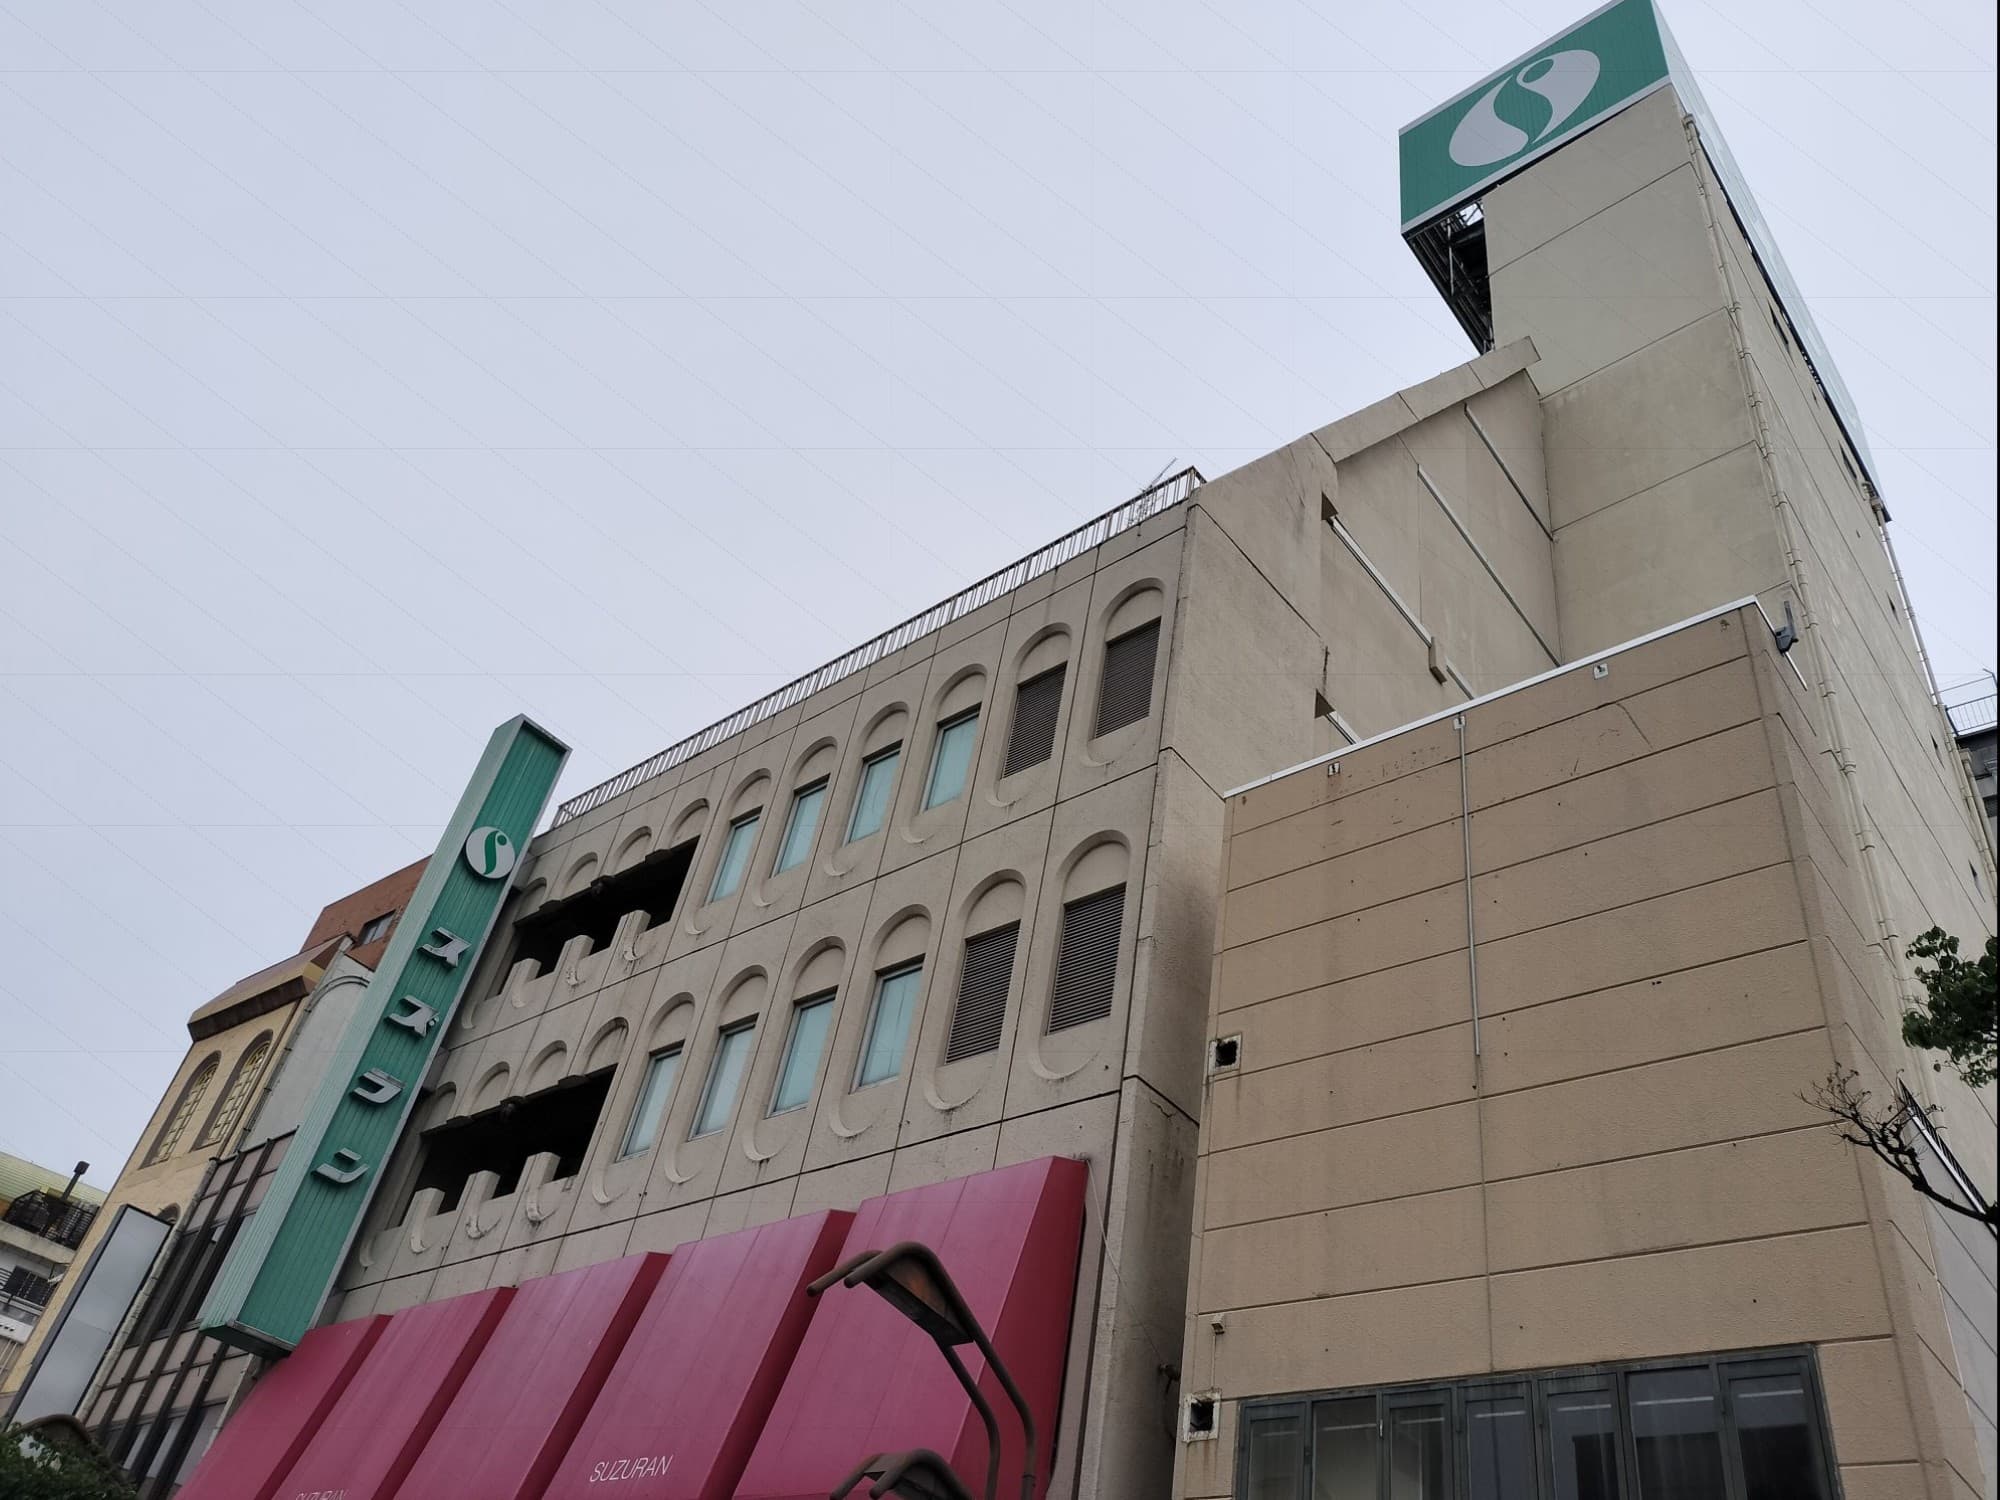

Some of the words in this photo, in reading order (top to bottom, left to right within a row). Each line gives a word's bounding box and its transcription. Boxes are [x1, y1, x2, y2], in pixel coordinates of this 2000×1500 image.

[312, 926, 471, 1184] スズラン
[590, 1455, 673, 1482] SUZURAN
